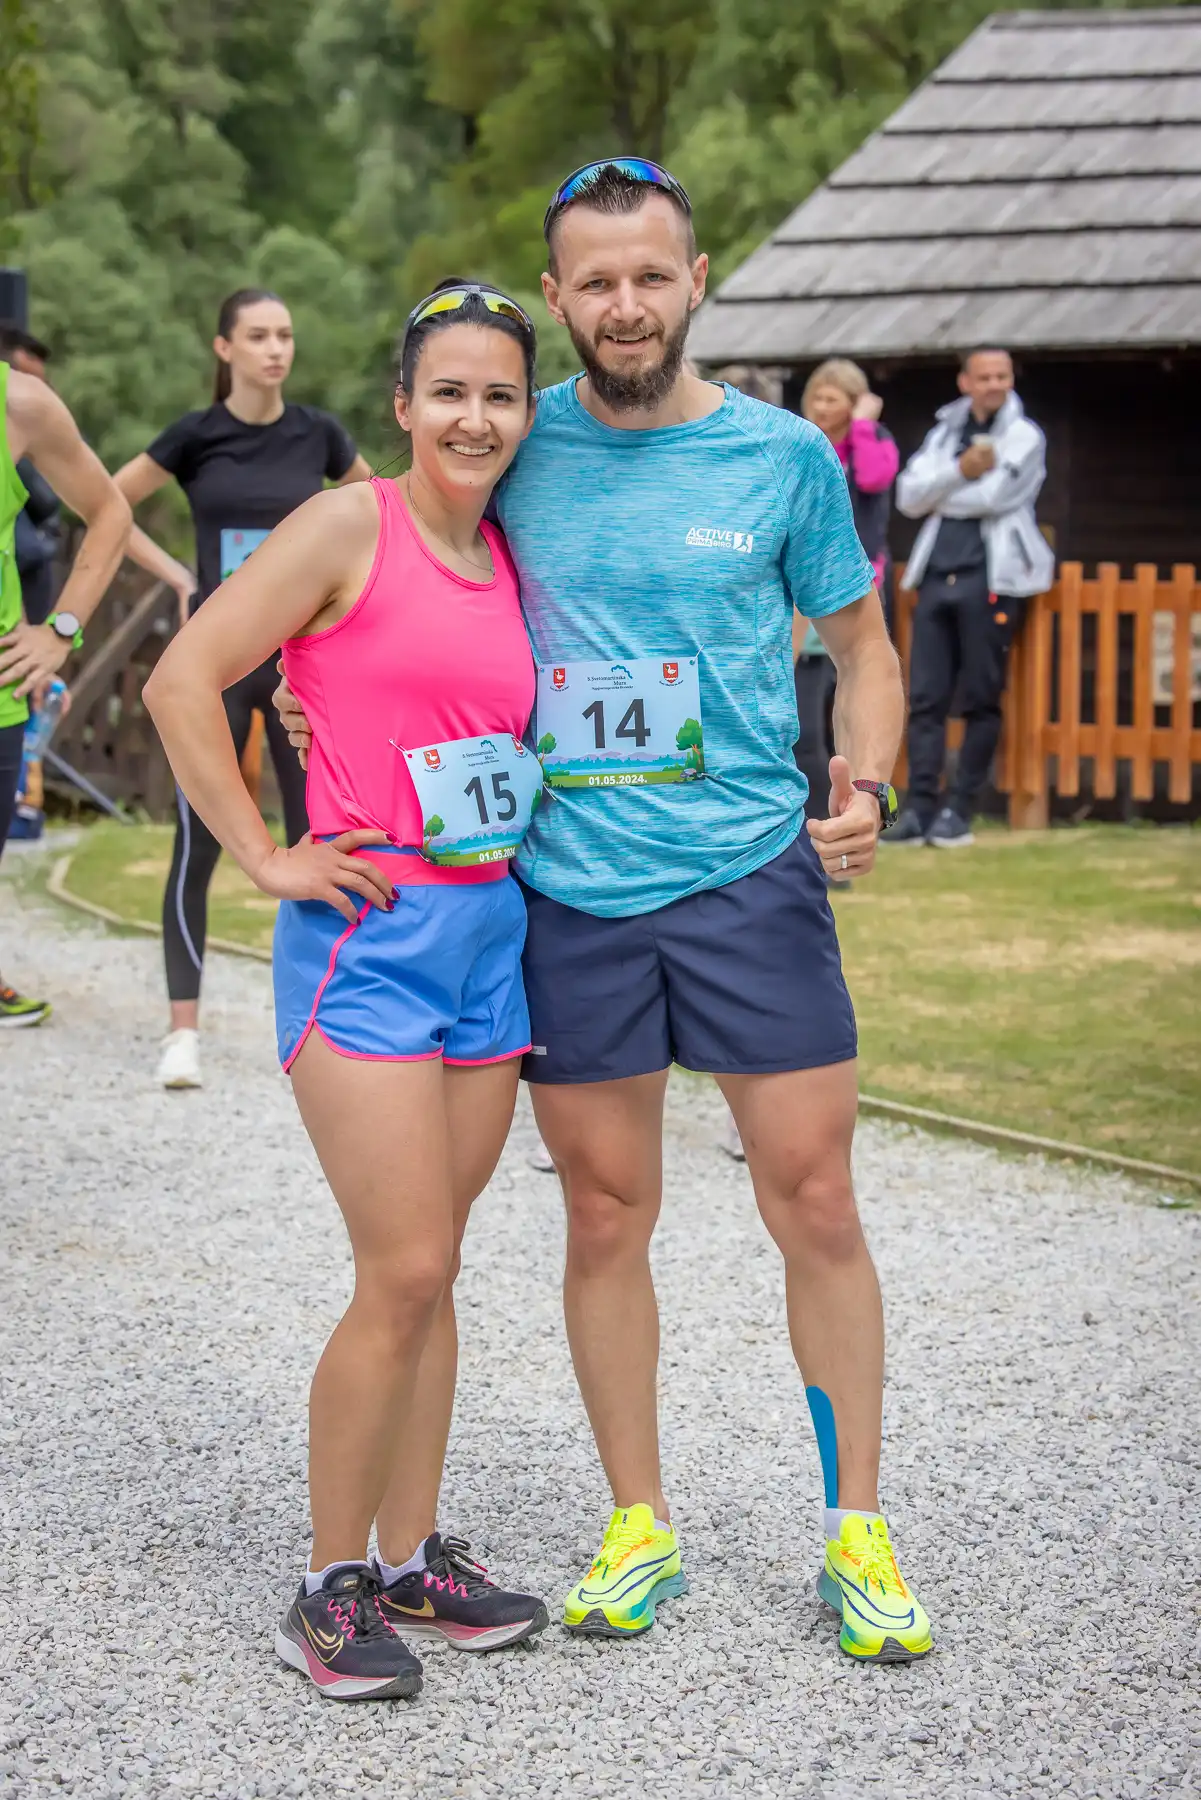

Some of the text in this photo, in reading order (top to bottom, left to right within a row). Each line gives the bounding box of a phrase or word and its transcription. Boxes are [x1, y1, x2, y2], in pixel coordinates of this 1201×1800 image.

[687, 527, 734, 542] ACTIVE
[687, 538, 731, 548] PRIMA BIRO
[582, 698, 651, 749] 14
[588, 774, 648, 786] 01.05.2024.
[464, 772, 516, 824] 15
